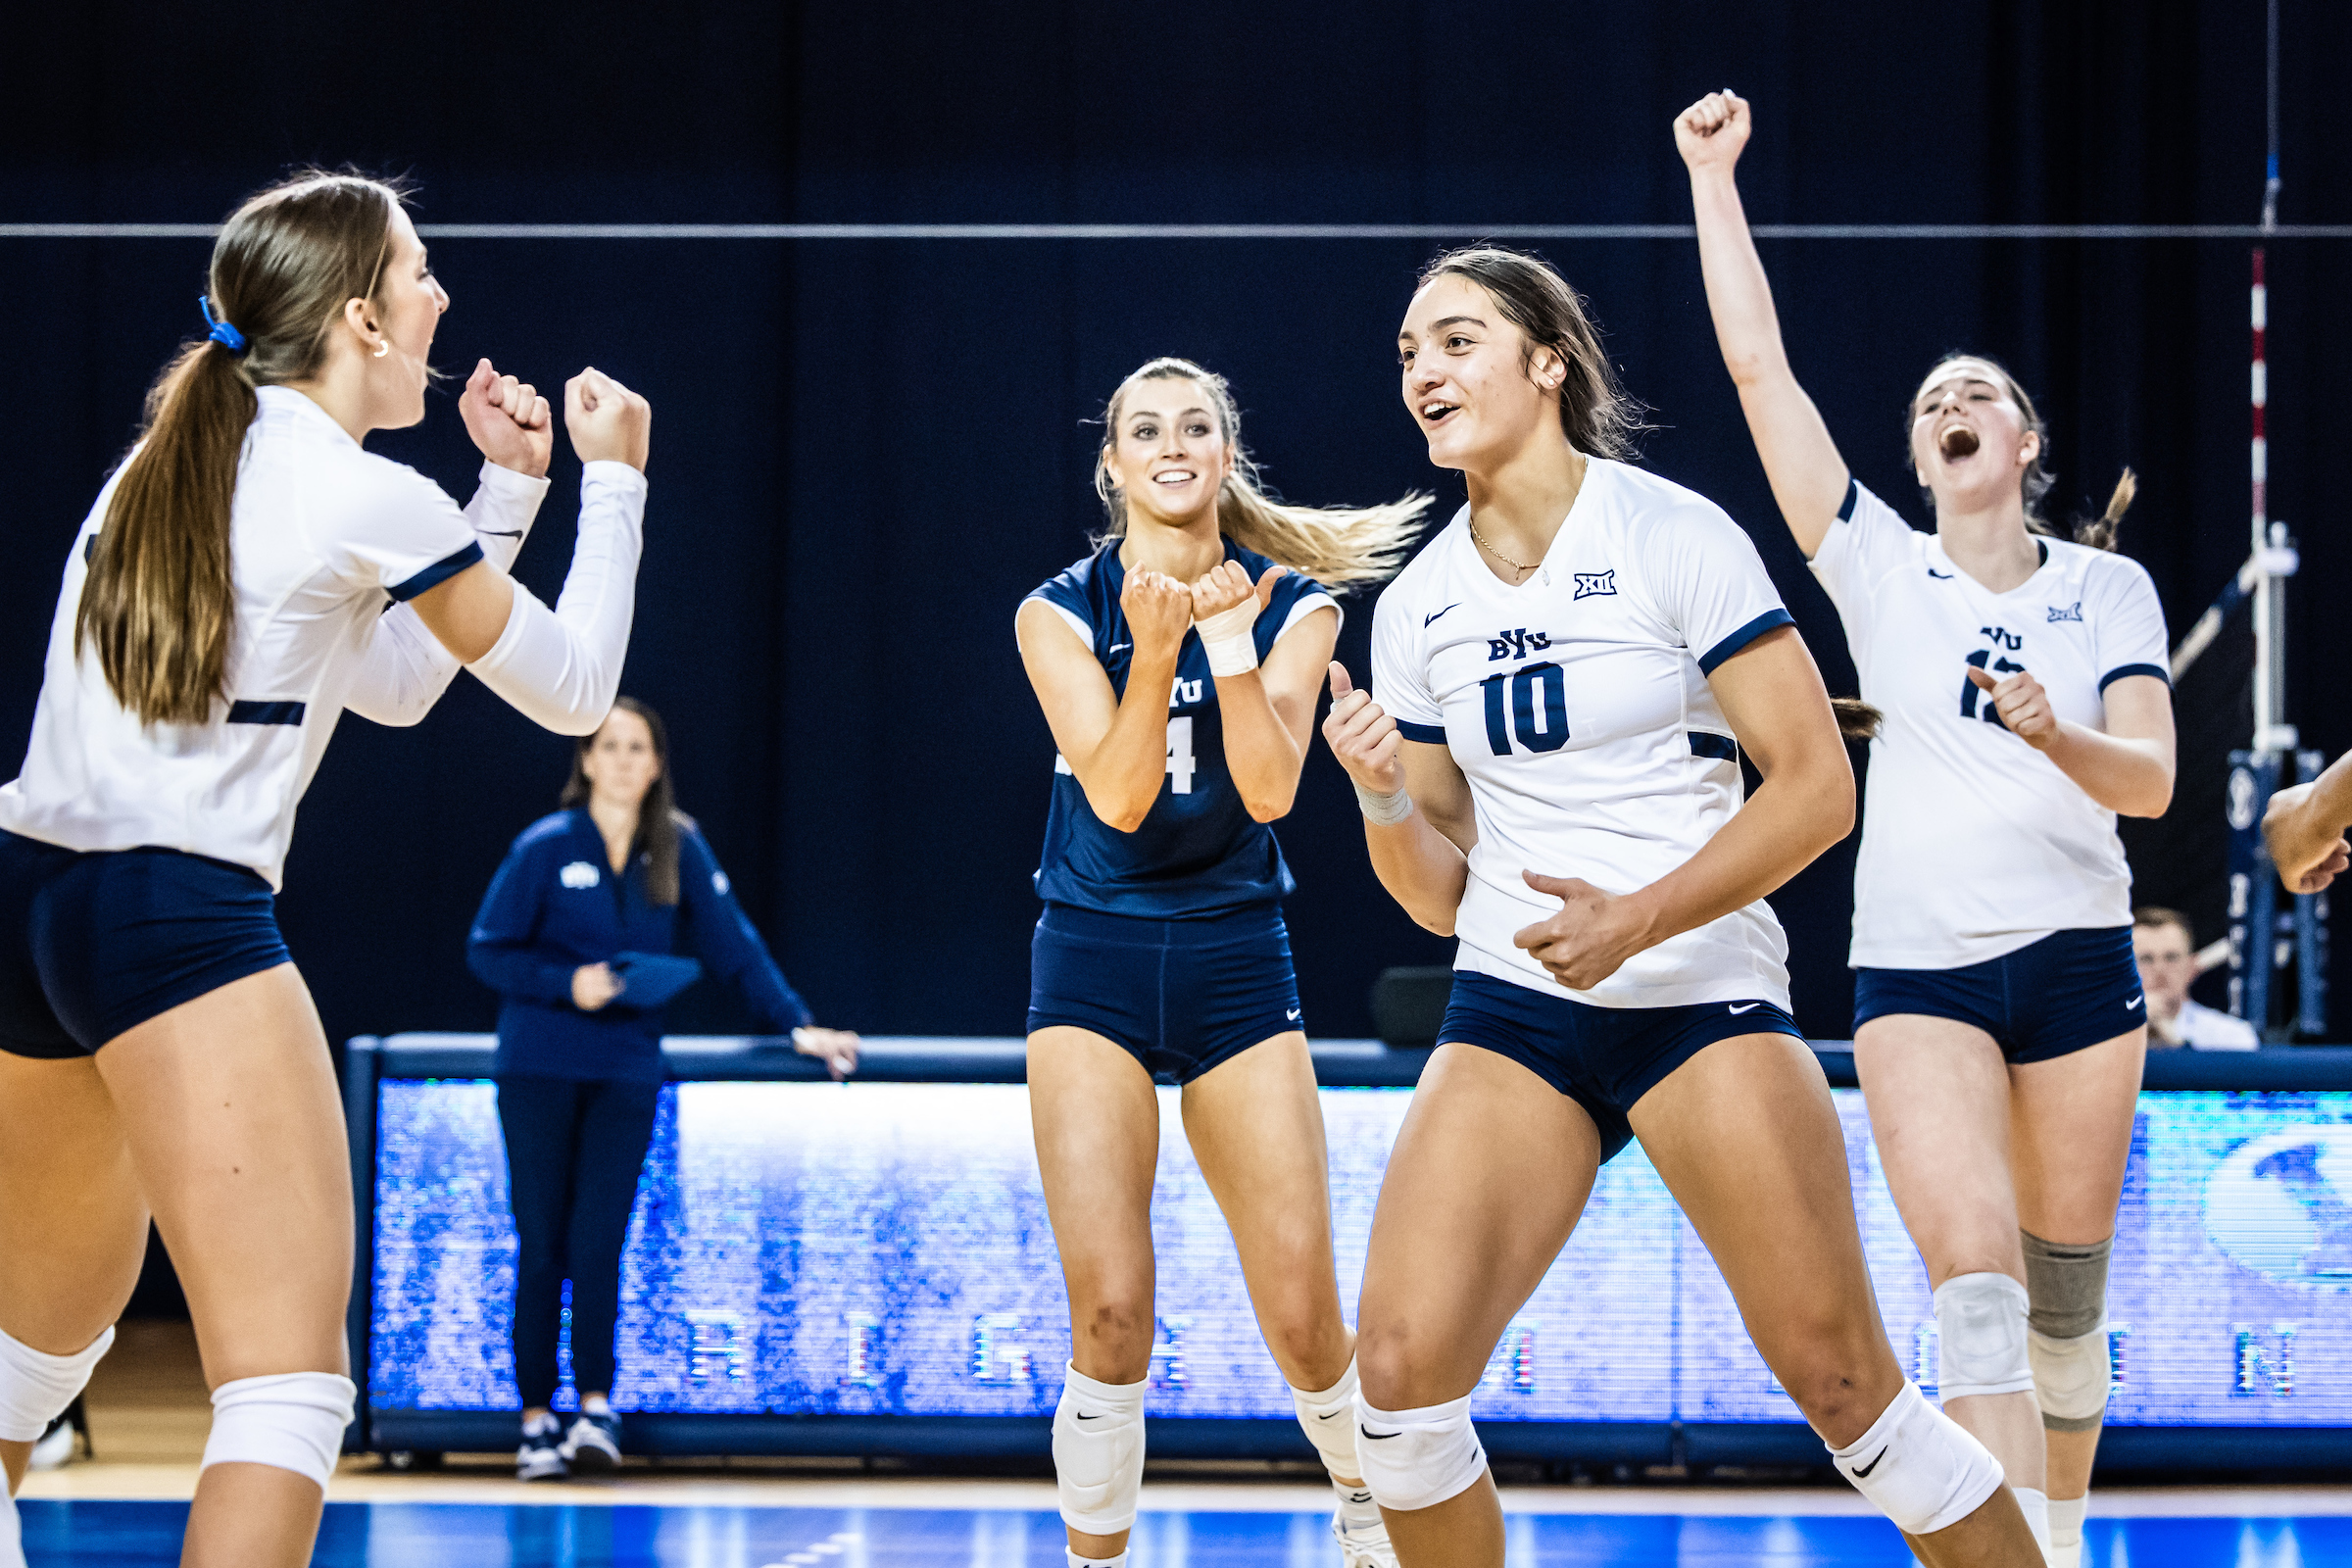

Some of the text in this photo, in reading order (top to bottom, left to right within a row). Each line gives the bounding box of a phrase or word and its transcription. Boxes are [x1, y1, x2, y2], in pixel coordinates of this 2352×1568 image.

[1487, 627, 1551, 662] BYU
[1479, 661, 1570, 757] 10
[1165, 715, 1196, 795] 4
